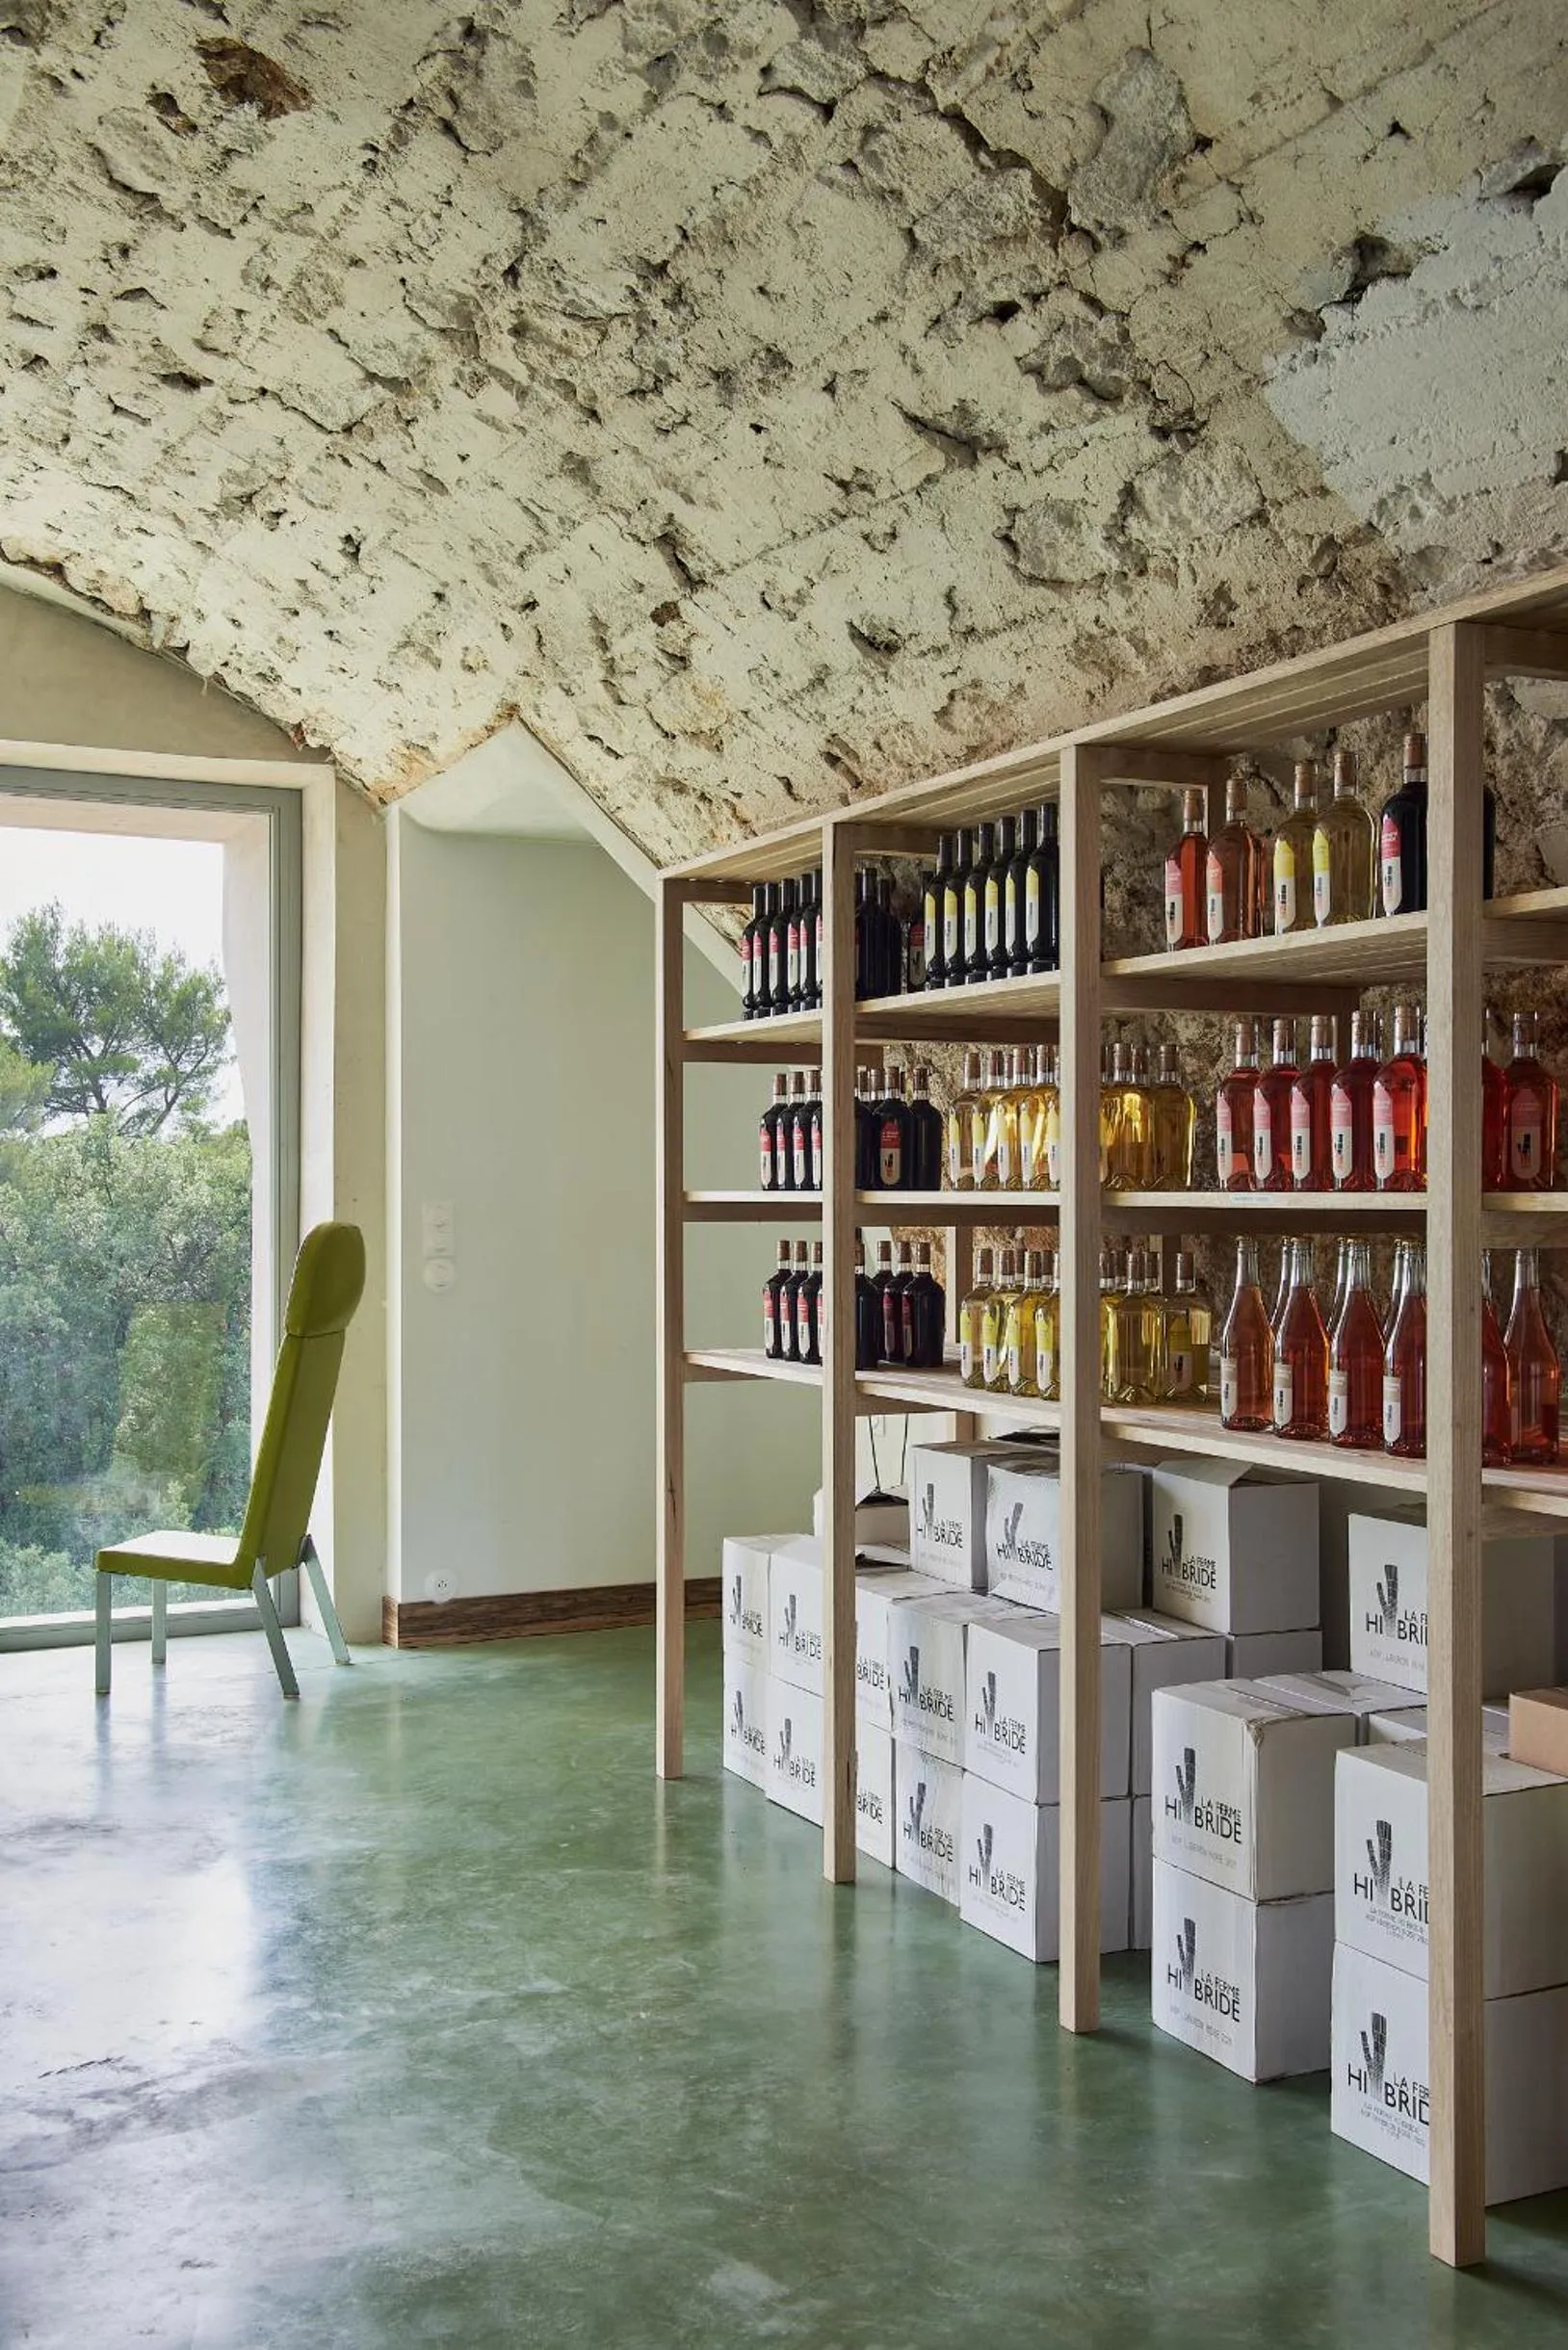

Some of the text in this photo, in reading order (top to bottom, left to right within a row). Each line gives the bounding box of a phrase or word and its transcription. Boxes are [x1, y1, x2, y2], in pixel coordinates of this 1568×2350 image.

[1018, 1547, 1054, 1571] BRIDE
[1182, 1563, 1216, 1589] BRIDE
[1366, 1612, 1428, 1647] HI BRI
[919, 1693, 954, 1722] BRIDE
[975, 1713, 986, 1736] HI
[994, 1723, 1027, 1755] BRIDE
[1165, 1795, 1241, 1844] HI BRIDE
[920, 1831, 954, 1863] BRIDE
[969, 1865, 1026, 1912] HI BRIDE
[1354, 1872, 1373, 1902] HI
[1391, 1888, 1429, 1924] BRI
[1167, 1963, 1241, 2023] HI BRIDE
[1348, 2063, 1367, 2095] HI
[1384, 2081, 1430, 2127] BRID
